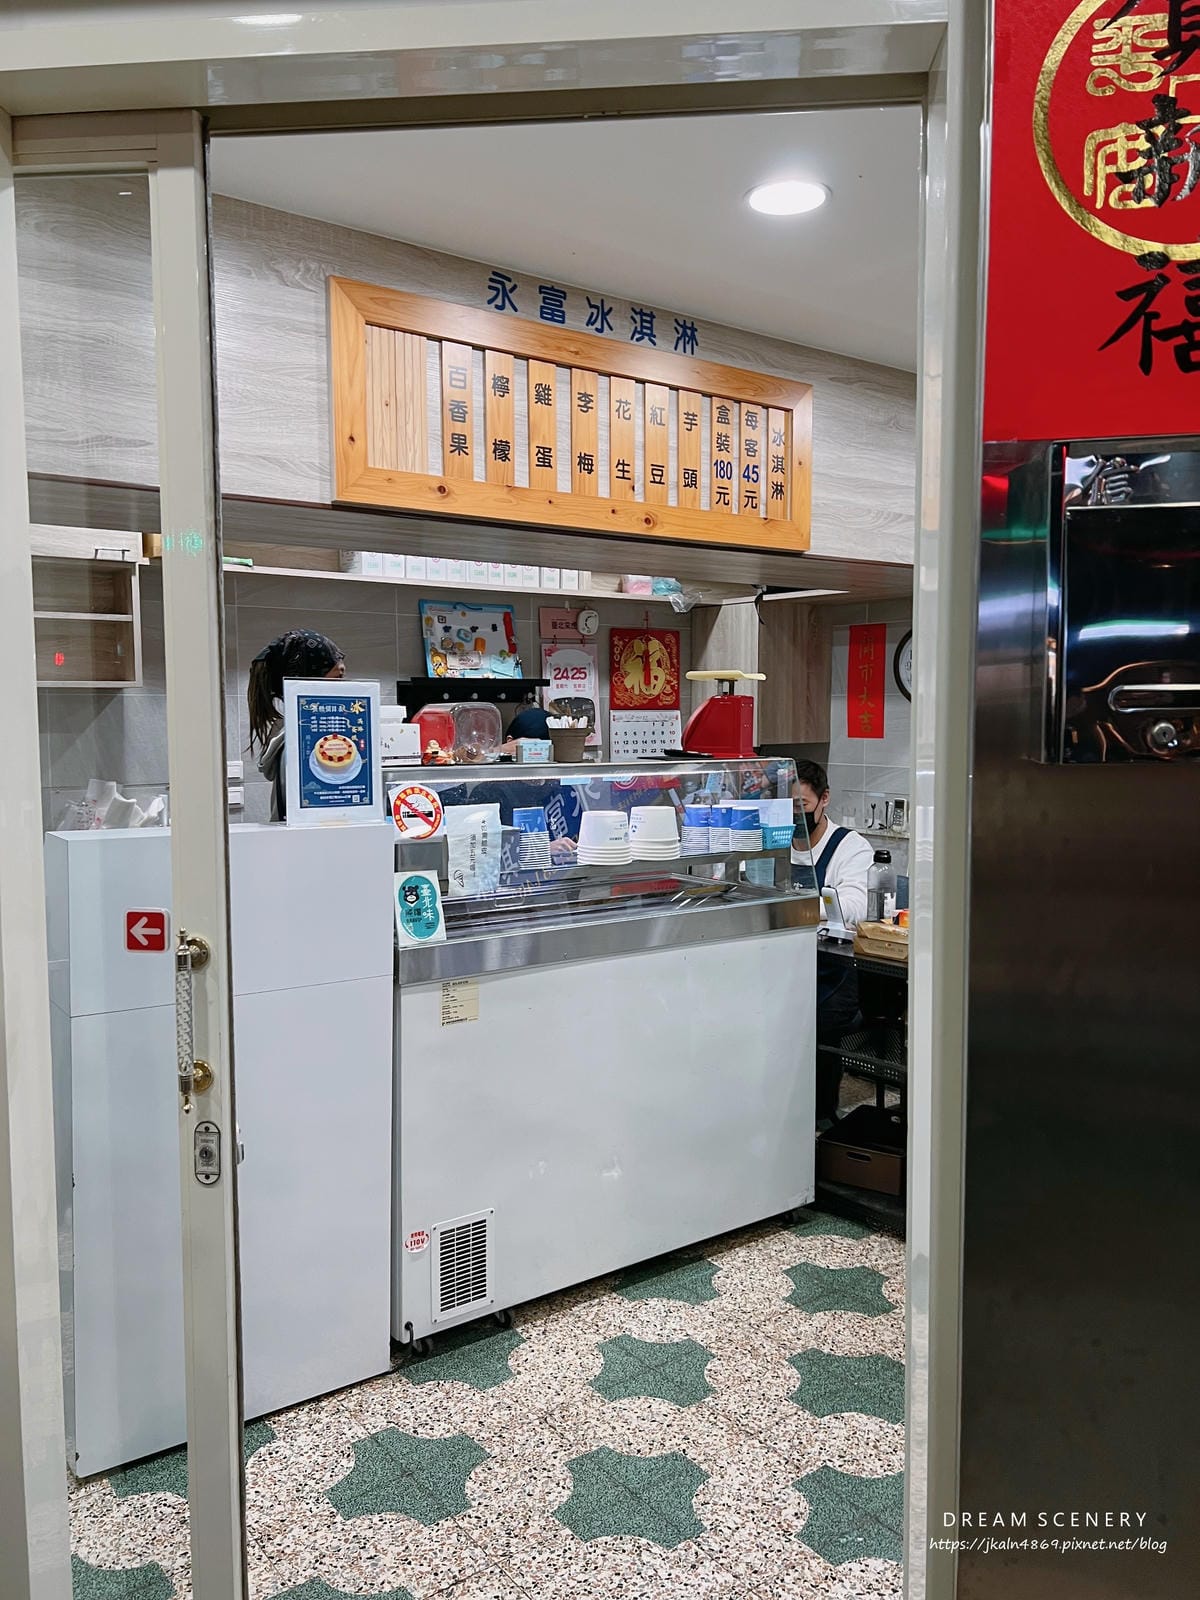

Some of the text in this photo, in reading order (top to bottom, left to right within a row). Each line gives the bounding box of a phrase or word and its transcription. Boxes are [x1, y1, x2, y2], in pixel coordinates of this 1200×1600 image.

[487, 270, 700, 356] 永富冰淇淋
[447, 365, 470, 458] 百香果
[491, 373, 511, 464] 檸檬
[534, 383, 554, 470] 雞蛋
[576, 391, 595, 476] 李梅
[614, 398, 633, 482] 花生
[648, 406, 666, 487] 紅豆
[682, 411, 699, 490] 芋頭
[712, 404, 734, 508] 盒裝180元
[742, 410, 761, 511] 每客45元
[770, 425, 787, 501] 冰淇淋
[570, 667, 587, 680] 25
